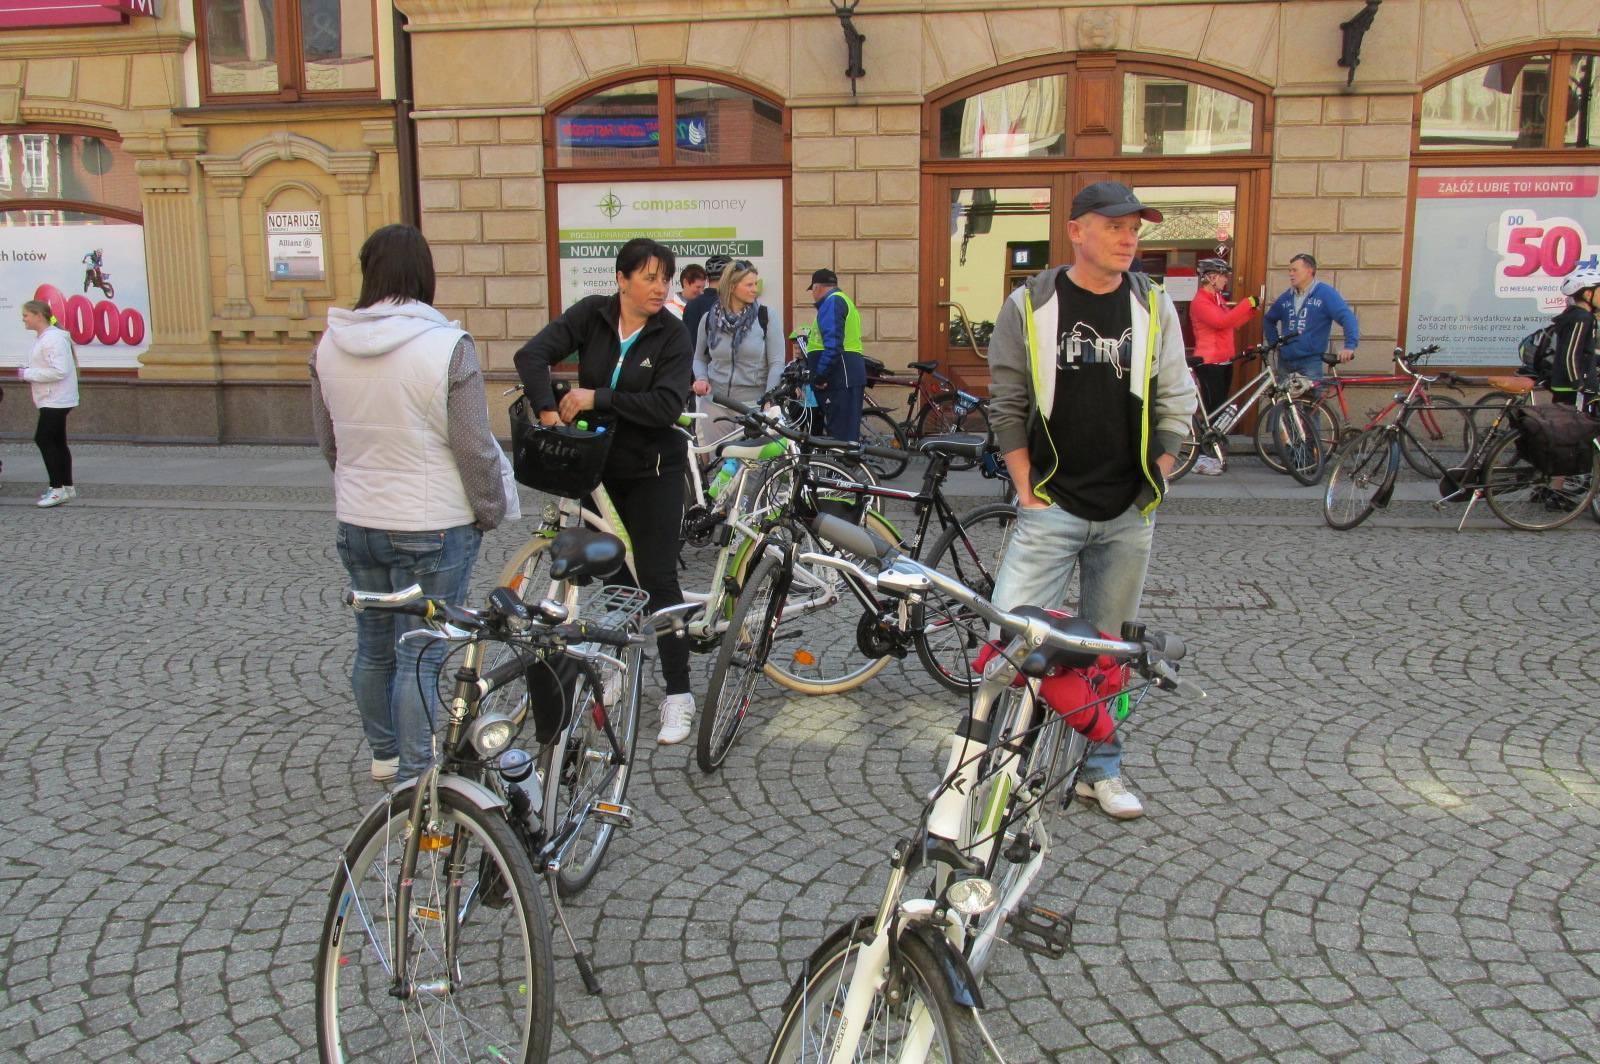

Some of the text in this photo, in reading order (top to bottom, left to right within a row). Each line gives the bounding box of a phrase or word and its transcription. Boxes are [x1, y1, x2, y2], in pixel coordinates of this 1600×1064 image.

[1438, 180, 1574, 195] ZAŁÓŻ LUBIĘ TO! KONTO
[632, 199, 746, 212] compassmoney
[269, 214, 320, 227] NOTARIUSZ
[1508, 215, 1524, 226] DO
[279, 239, 302, 247] Allianz
[12, 249, 47, 262] lotów
[570, 246, 610, 257] NOWY
[1503, 226, 1582, 277] 50
